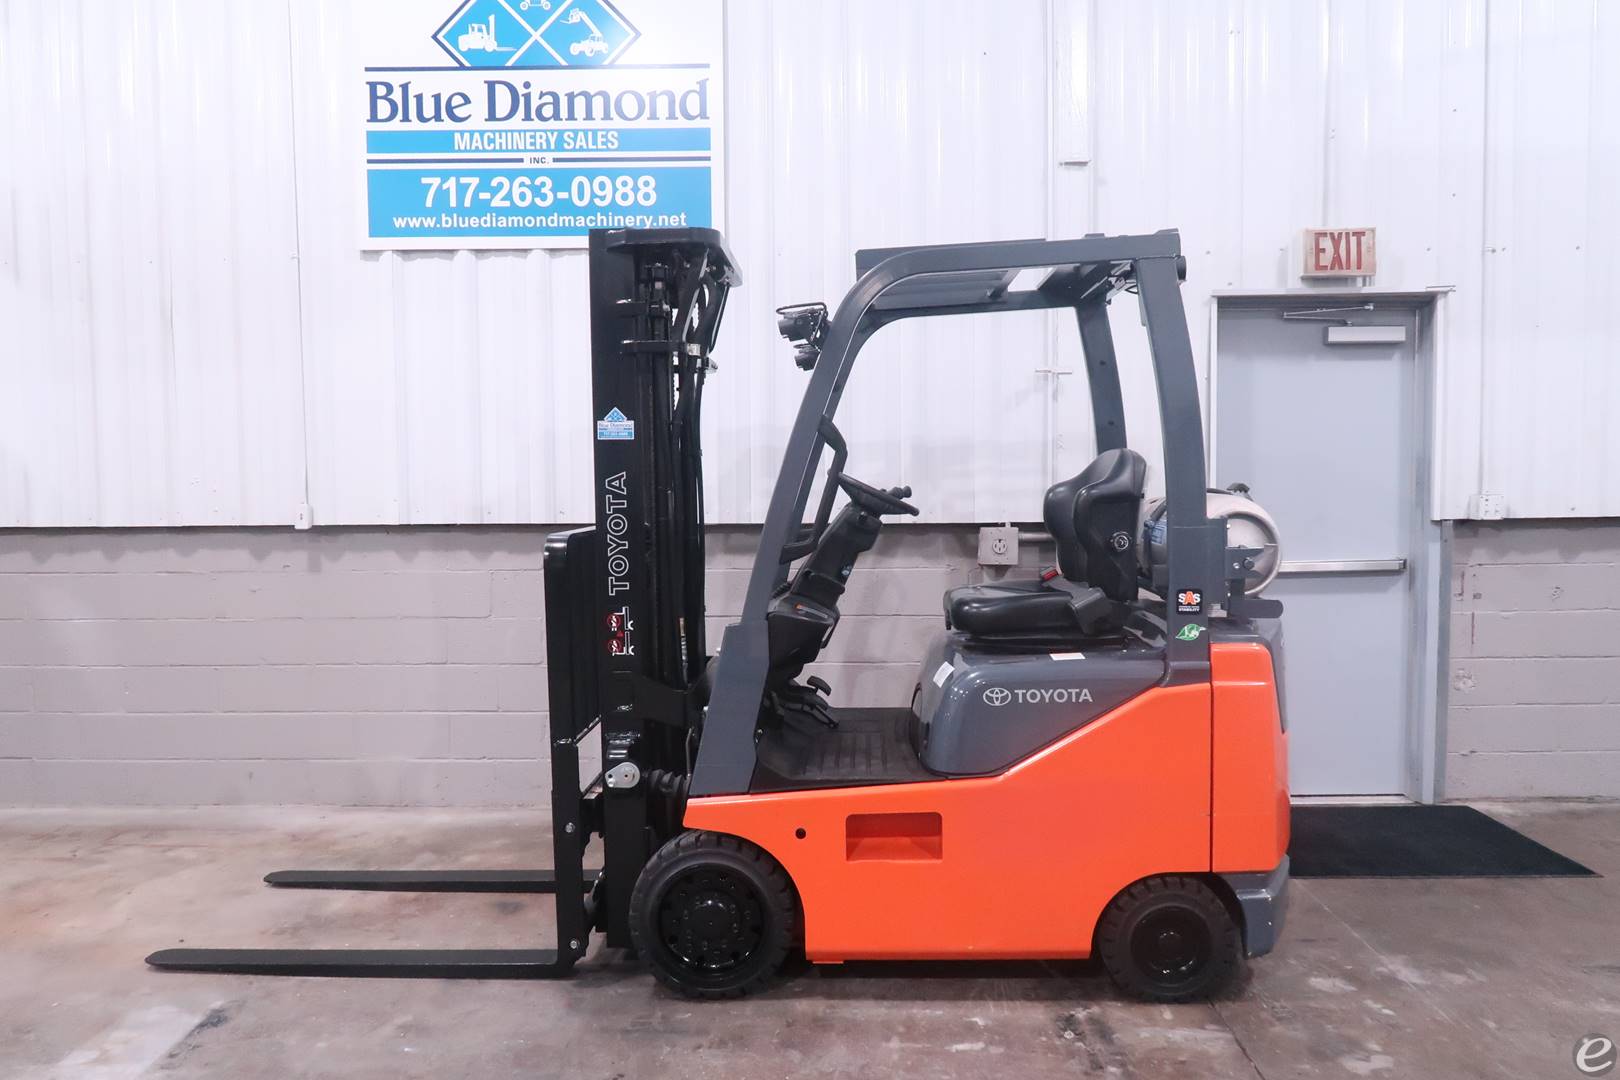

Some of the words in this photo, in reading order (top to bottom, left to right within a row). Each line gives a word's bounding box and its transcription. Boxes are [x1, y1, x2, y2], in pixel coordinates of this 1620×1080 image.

[366, 80, 472, 123] Blue
[484, 77, 710, 122] Diamond
[454, 131, 557, 151] MACHINERY
[563, 130, 619, 150] SALES
[529, 156, 550, 165] INC.
[420, 175, 657, 208] 717-263-0988
[393, 212, 687, 229] www.bluediamondmachinery.net
[1314, 231, 1366, 271] EXIT
[605, 471, 630, 596] TOYOTA
[1178, 591, 1201, 606] SAS
[1014, 688, 1093, 704] TOYOTA
